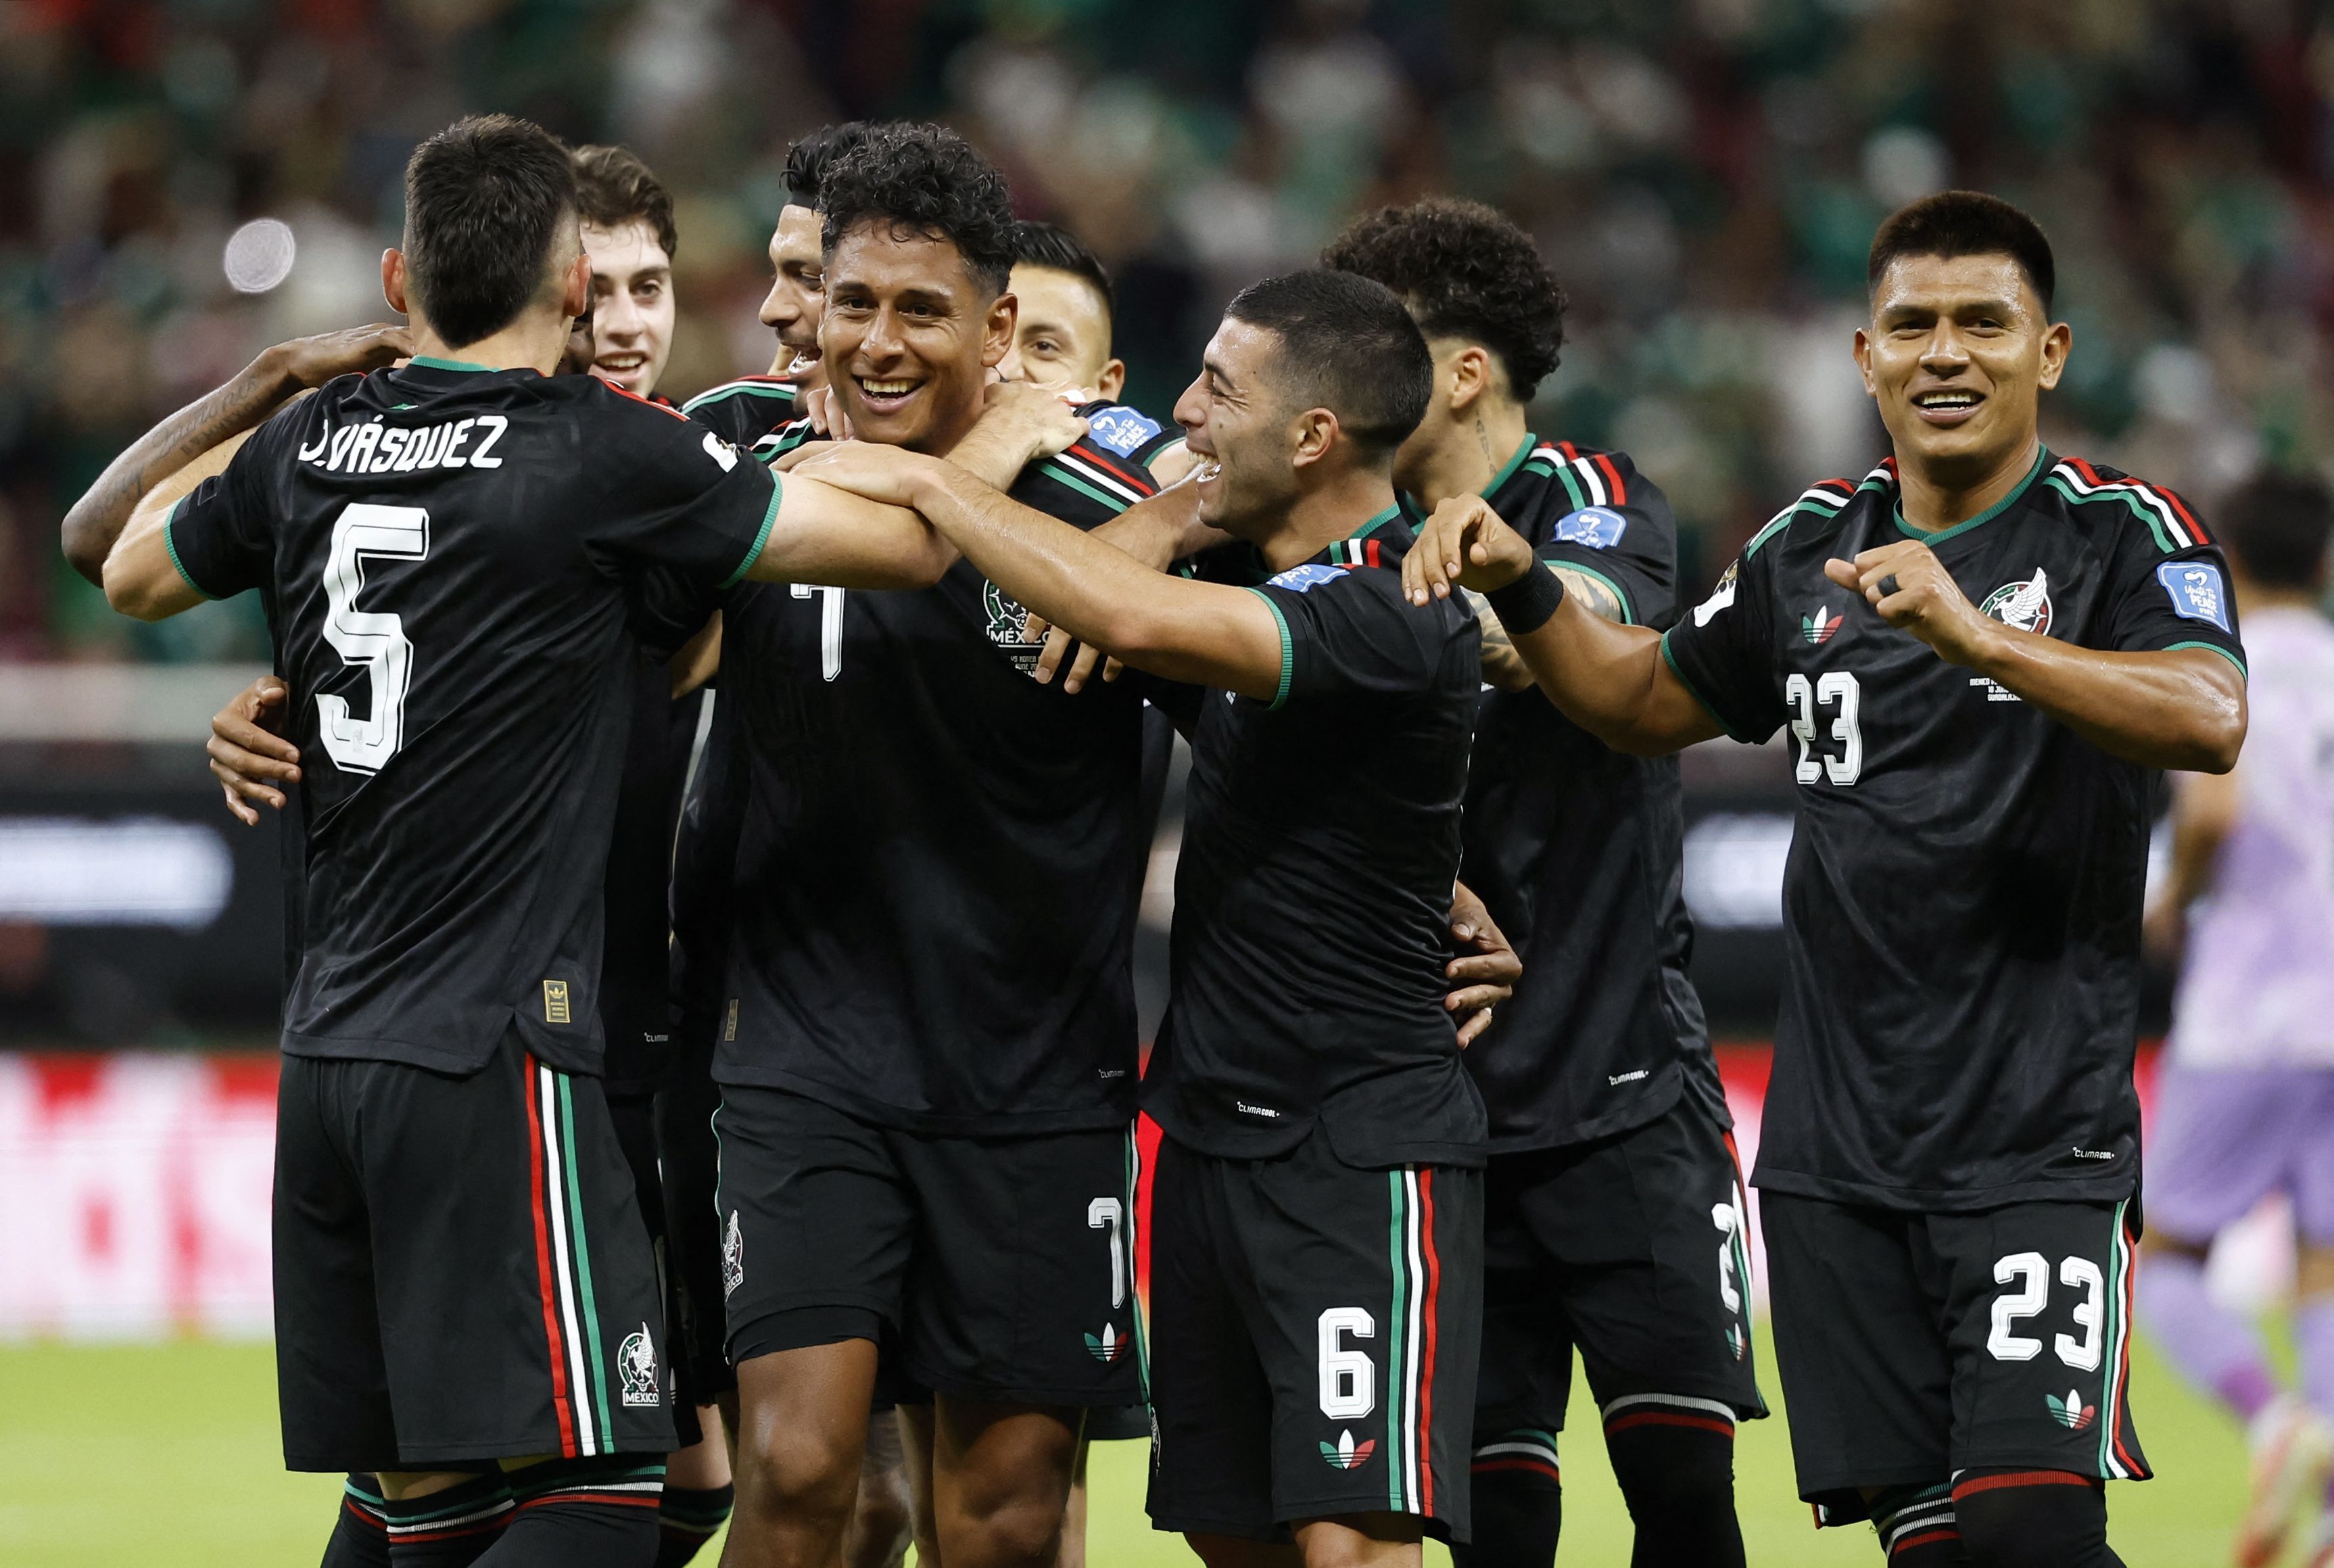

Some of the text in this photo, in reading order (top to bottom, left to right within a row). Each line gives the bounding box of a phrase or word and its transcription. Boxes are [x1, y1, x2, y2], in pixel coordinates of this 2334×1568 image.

[298, 414, 508, 473] J.VÁSQUEZ
[1118, 424, 1147, 450] PEACE
[315, 502, 430, 777] 5
[2190, 594, 2218, 614] PEACE
[1786, 671, 1862, 786] 23
[1088, 1197, 1125, 1308] 7
[1318, 1306, 1375, 1420] 6
[1986, 1252, 2104, 1372] 23
[625, 1389, 659, 1403] MÉXICO
